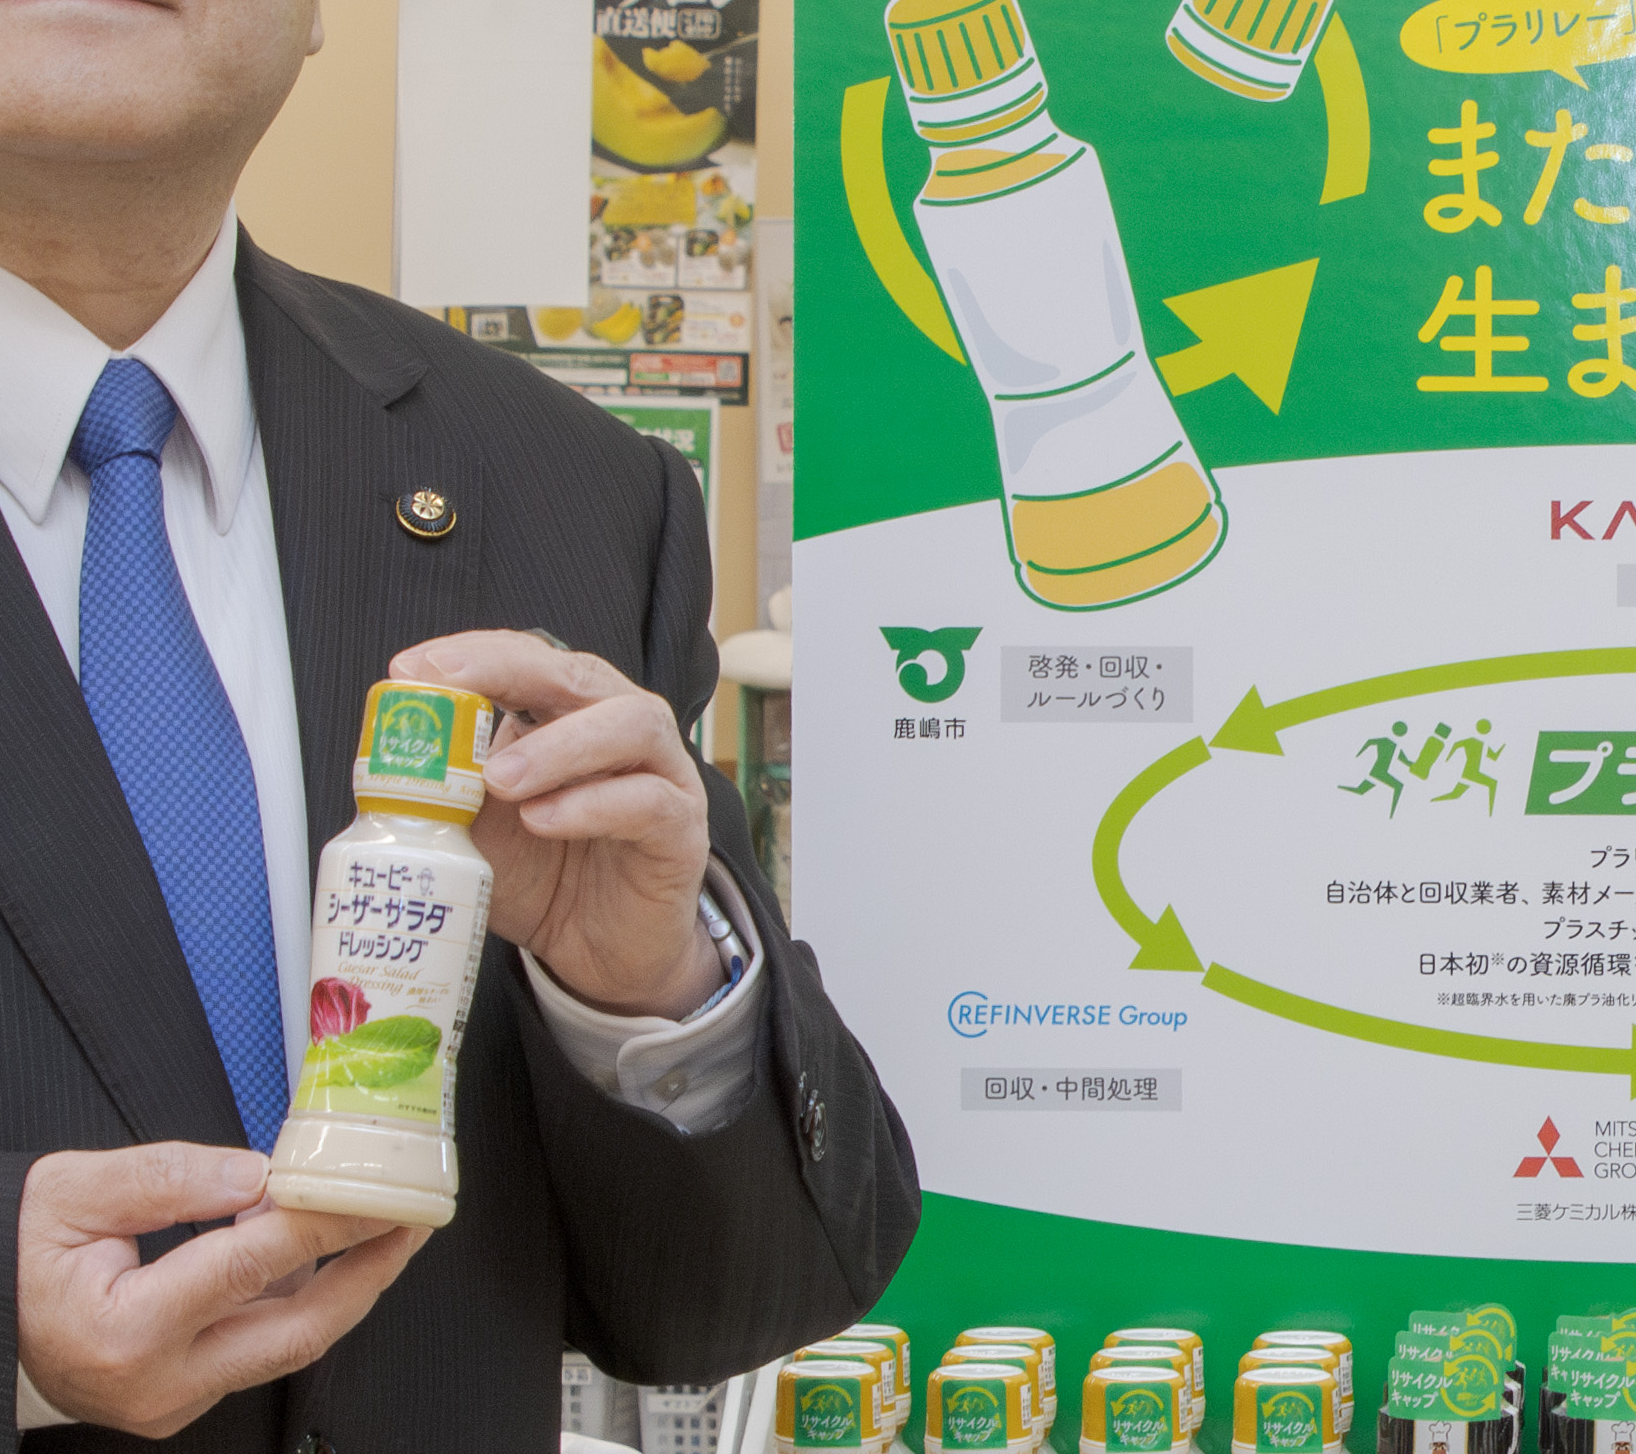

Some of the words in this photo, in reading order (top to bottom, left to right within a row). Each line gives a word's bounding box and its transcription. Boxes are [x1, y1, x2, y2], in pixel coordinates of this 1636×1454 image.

[1026, 685, 1168, 713] ルールづくり
[893, 716, 967, 741] 鹿嶋市
[349, 861, 413, 890] キューピー
[328, 894, 453, 934] シーザーサラダ
[338, 930, 428, 963] ドレッシング
[956, 1002, 1111, 1029] REFINVERSE
[1117, 1002, 1188, 1033] Group
[984, 1075, 1159, 1103] 回収・中間処理
